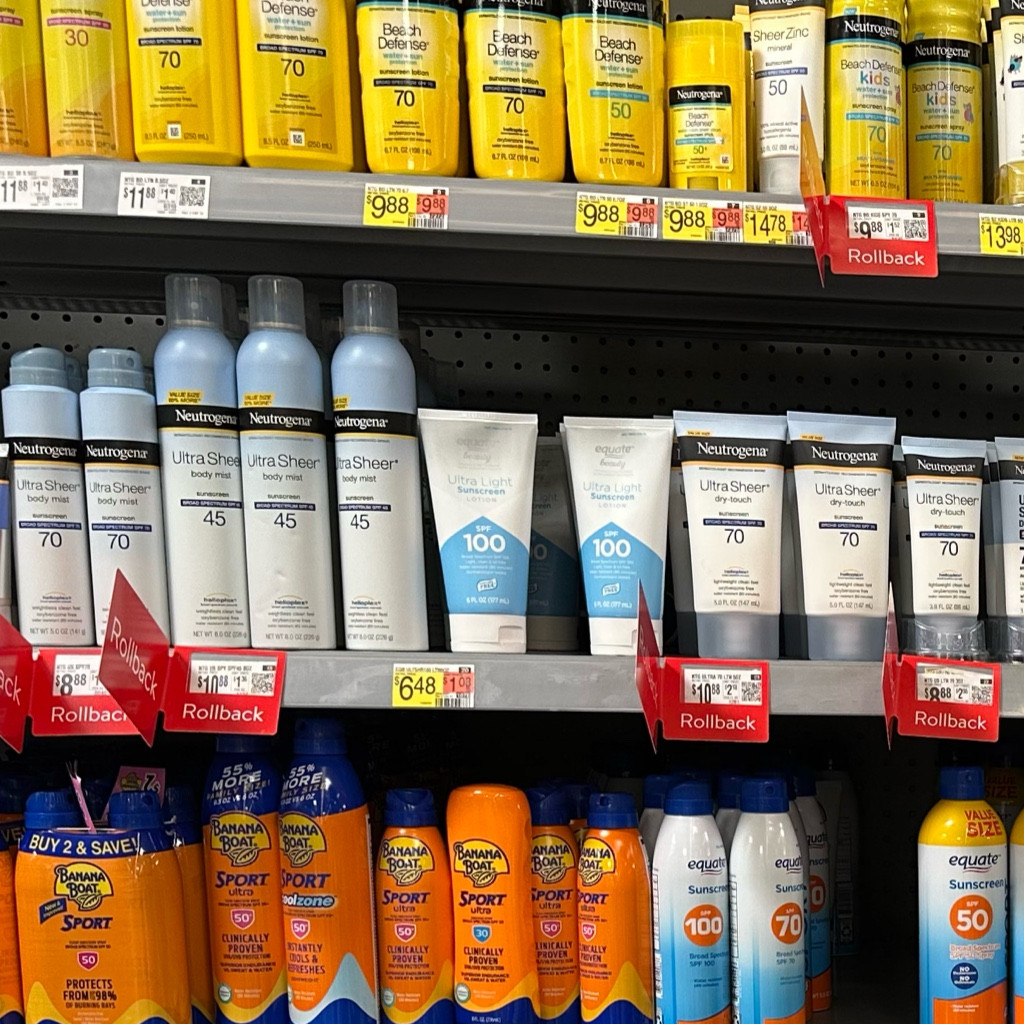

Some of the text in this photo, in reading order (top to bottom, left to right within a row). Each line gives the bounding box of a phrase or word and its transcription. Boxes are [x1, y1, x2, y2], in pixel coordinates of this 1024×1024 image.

[383, 24, 421, 38] Beach
[754, 27, 808, 42] Sheer Zinc
[159, 51, 180, 68] 70
[769, 80, 787, 96] 50
[394, 90, 414, 107] 70
[926, 93, 956, 106] kids
[932, 145, 952, 160] 70
[848, 249, 924, 265] Rollback
[17, 481, 43, 492] Ultra
[448, 475, 512, 488] Ultra Light
[701, 481, 728, 493] Ultra
[457, 486, 505, 496] Sunscreen
[28, 495, 69, 505] body mist
[715, 495, 751, 504] dry-touch
[274, 513, 296, 529] 45
[39, 532, 62, 548] 70
[464, 535, 505, 552] 100
[183, 704, 263, 722] Rollback
[681, 714, 756, 730] Rollback
[915, 711, 987, 731] Rollback
[29, 834, 137, 855] BUY 2 & SAVE!
[57, 867, 105, 883] BANANA
[69, 882, 101, 896] BOAT
[459, 891, 506, 906] SPORT
[471, 906, 492, 914] ultra
[61, 917, 113, 931] SPORT
[686, 917, 722, 935] 100
[222, 933, 269, 944] CLINICALLY
[475, 929, 488, 938] 30
[228, 944, 263, 953] PROVEN
[66, 979, 113, 989] PROTECTS
